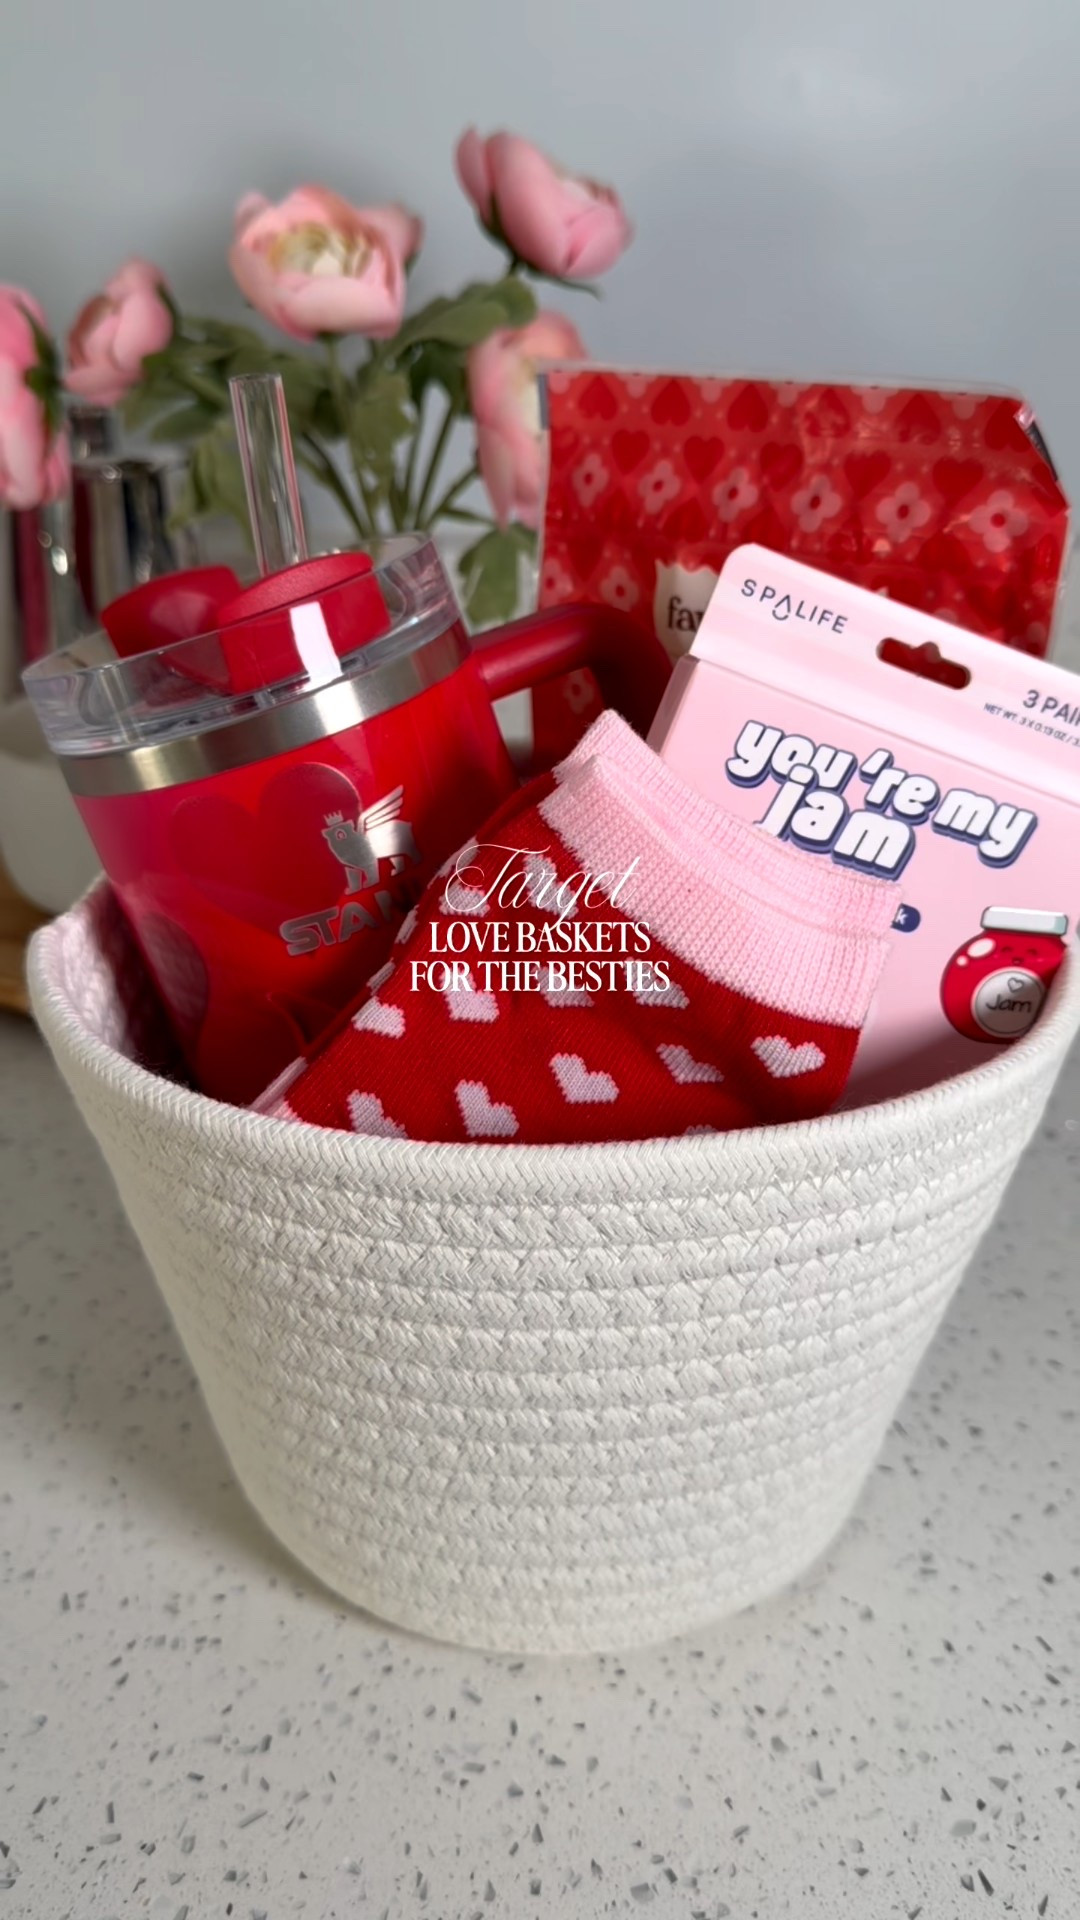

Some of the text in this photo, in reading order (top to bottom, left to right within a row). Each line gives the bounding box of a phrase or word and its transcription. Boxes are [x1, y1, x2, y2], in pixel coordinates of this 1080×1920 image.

[983, 702, 1003, 716] NET
[1022, 689, 1040, 709] 3
[726, 720, 1038, 869] you're my
[753, 763, 916, 881] jam
[985, 994, 1032, 1013] Jam
